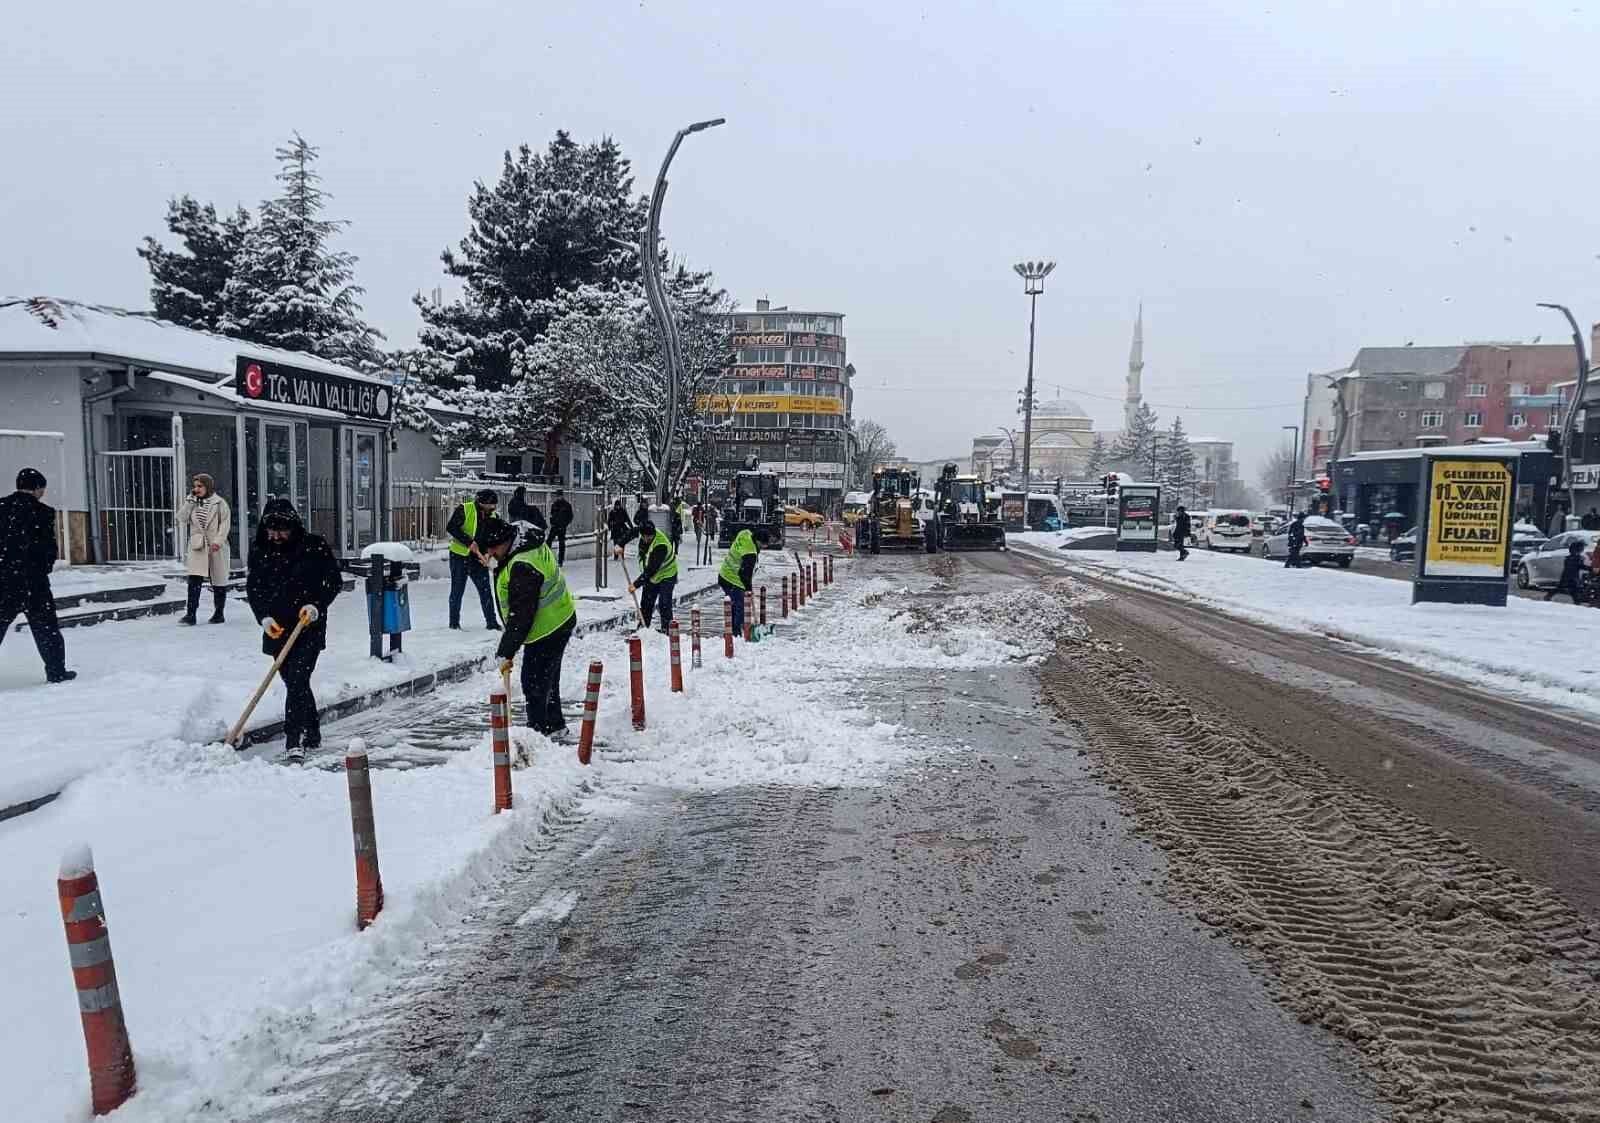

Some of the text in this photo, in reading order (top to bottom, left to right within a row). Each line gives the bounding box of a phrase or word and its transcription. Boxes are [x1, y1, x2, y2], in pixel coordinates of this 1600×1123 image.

[293, 378, 320, 406] VAN
[1443, 470, 1507, 480] GELENEKSEL
[1446, 501, 1498, 512] YÖRESEL
[1445, 510, 1498, 521] ÜRÜNLER
[1443, 527, 1497, 541] FUARI
